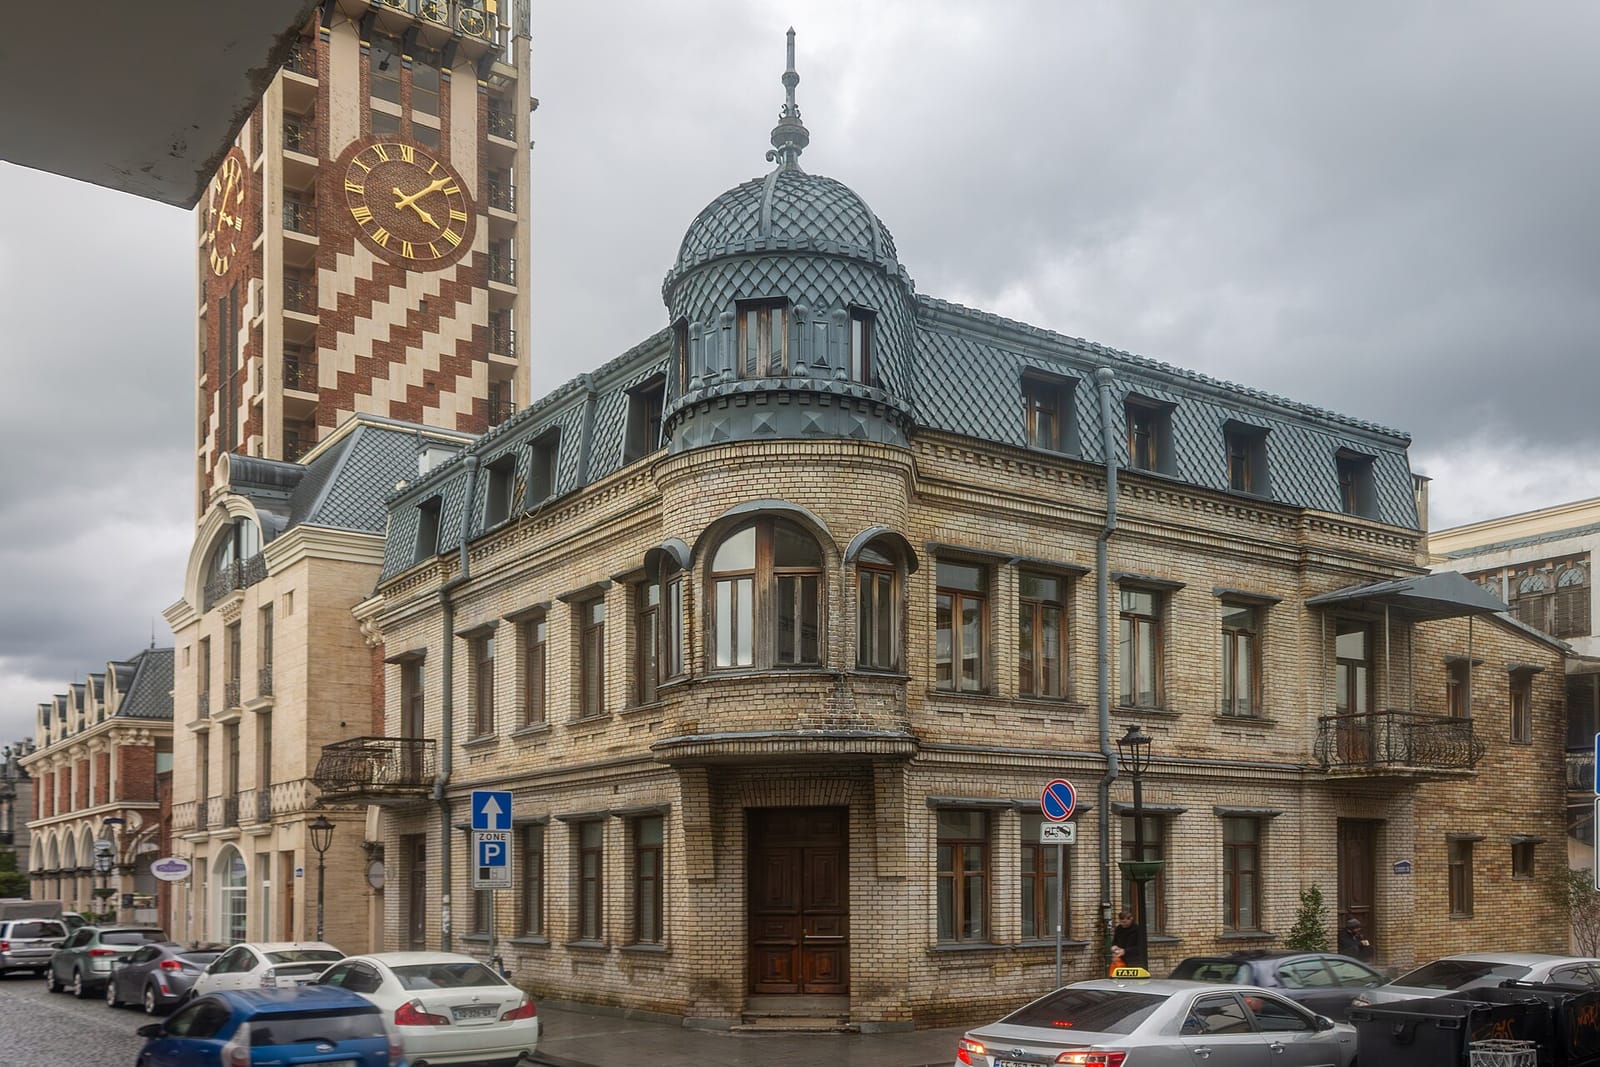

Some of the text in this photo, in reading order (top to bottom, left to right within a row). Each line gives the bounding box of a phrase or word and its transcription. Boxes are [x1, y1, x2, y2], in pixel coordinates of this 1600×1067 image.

[400, 143, 414, 164] XII
[449, 209, 467, 222] III
[479, 833, 506, 841] ZONE
[485, 843, 501, 865] P
